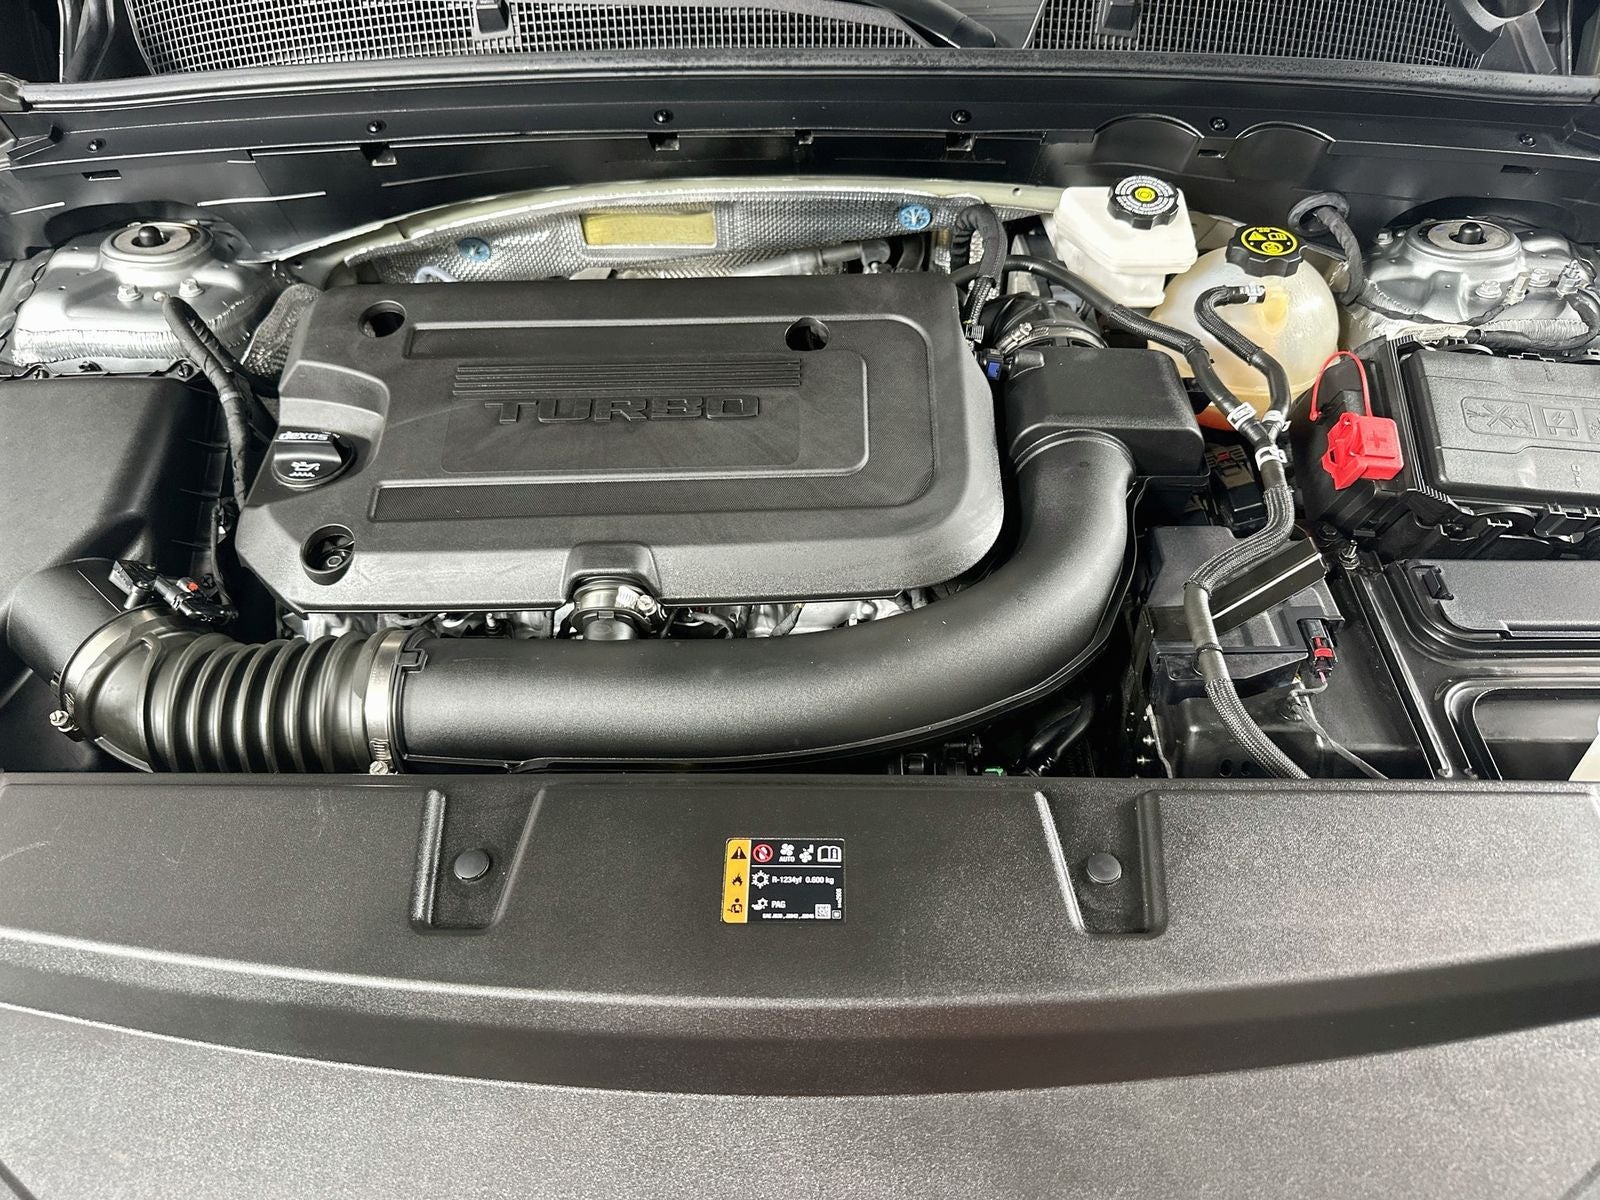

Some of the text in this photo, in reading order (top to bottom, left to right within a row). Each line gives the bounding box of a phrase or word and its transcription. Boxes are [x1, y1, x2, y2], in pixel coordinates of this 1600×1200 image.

[485, 395, 760, 425] TURBO
[278, 431, 329, 441] dexos
[772, 876, 802, 884] R-1234yf
[825, 876, 834, 885] kg
